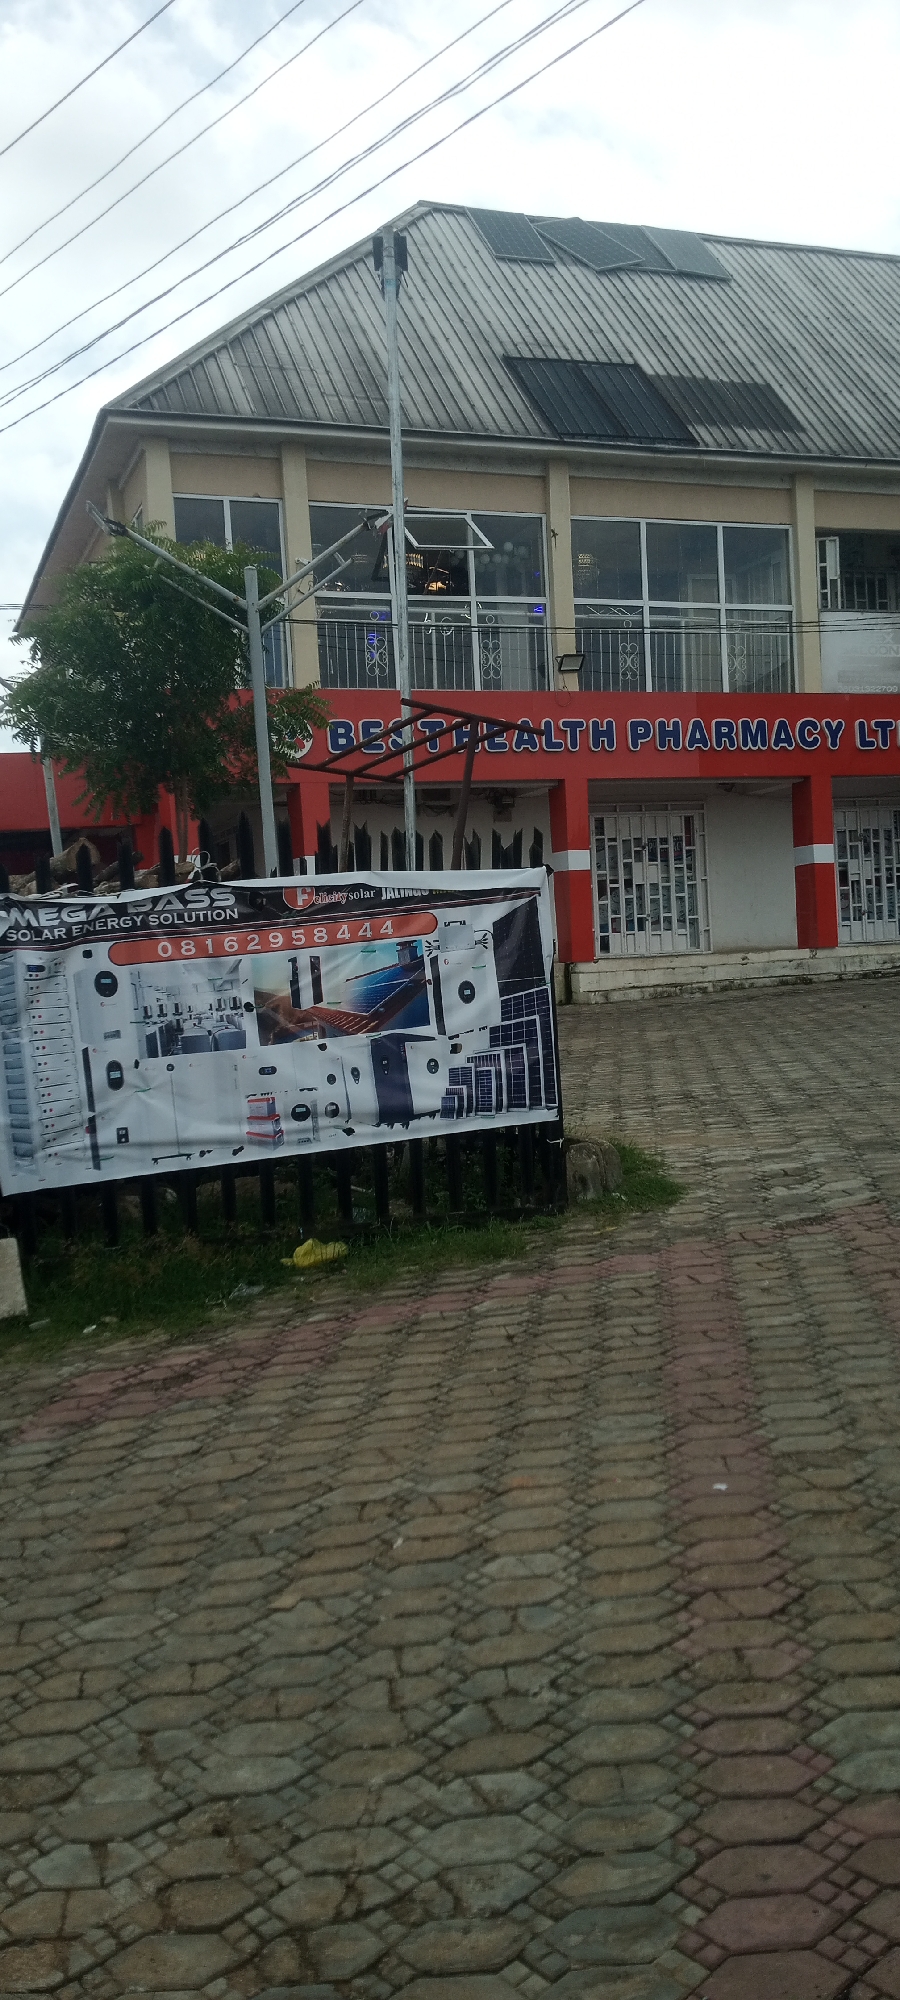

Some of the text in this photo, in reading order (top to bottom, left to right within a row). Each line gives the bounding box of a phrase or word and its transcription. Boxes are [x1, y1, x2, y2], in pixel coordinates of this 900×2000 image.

[627, 717, 845, 752] PHARMACY
[855, 718, 900, 750] LT
[127, 887, 236, 914] BASS
[6, 907, 239, 942] SOLAR ENERGY SOLUTION
[157, 920, 394, 958] 08162958444
